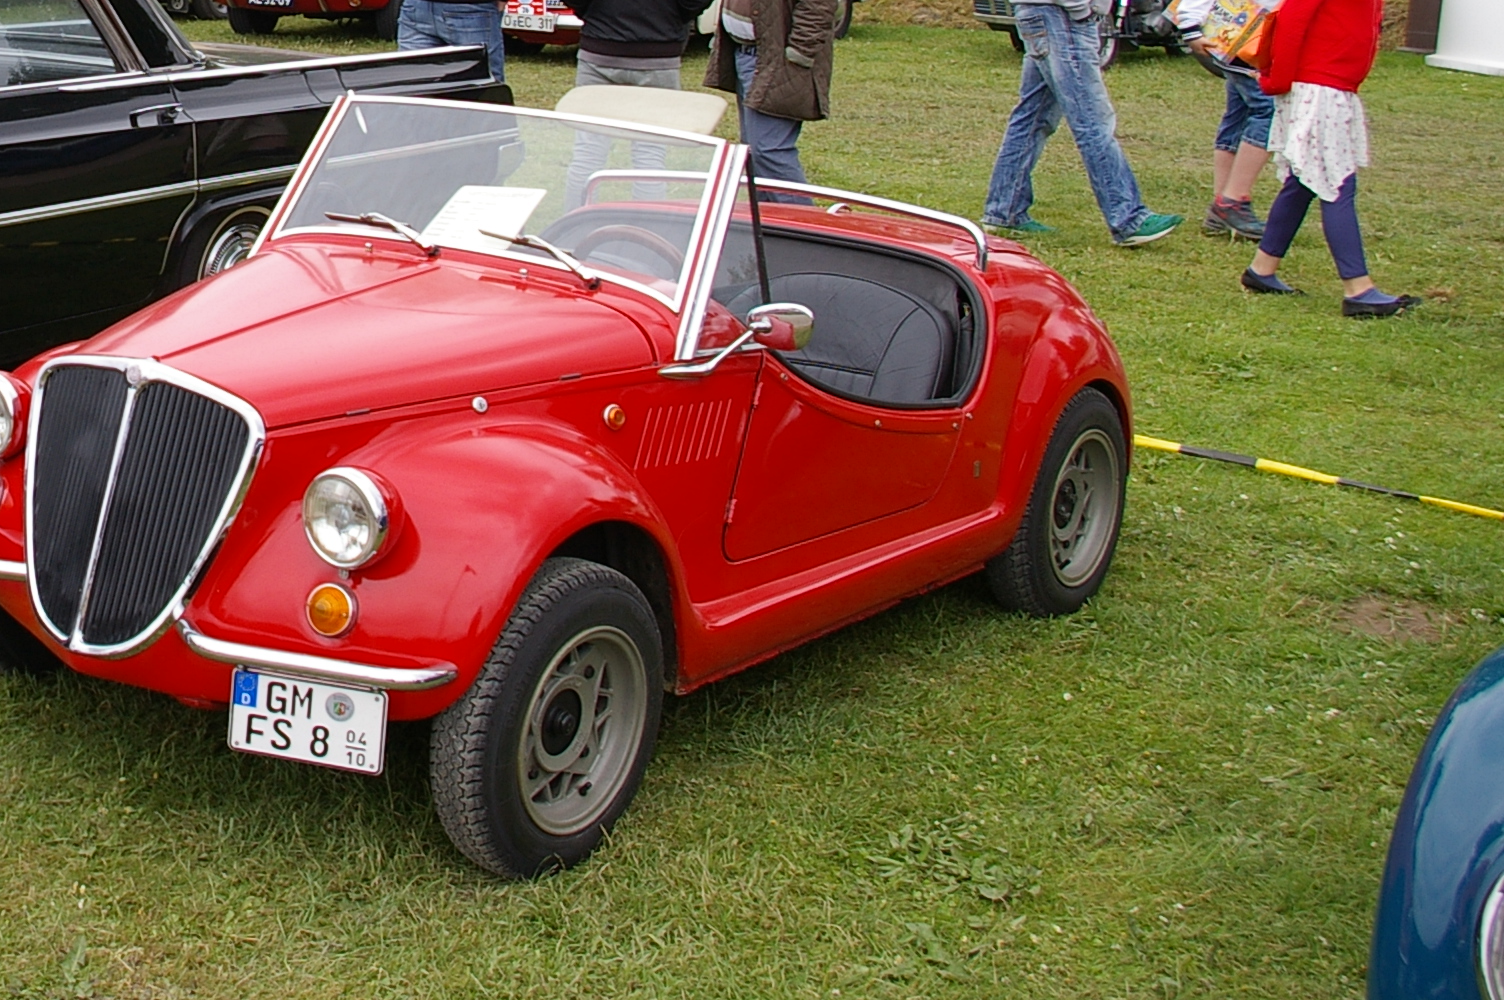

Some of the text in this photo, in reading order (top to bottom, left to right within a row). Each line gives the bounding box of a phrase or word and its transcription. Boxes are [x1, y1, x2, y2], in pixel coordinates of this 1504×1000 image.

[538, 17, 553, 30] 311
[241, 693, 251, 705] D
[266, 681, 314, 719] GM
[245, 713, 330, 758] FS 8
[346, 729, 367, 746] 04
[346, 751, 366, 767] 10
